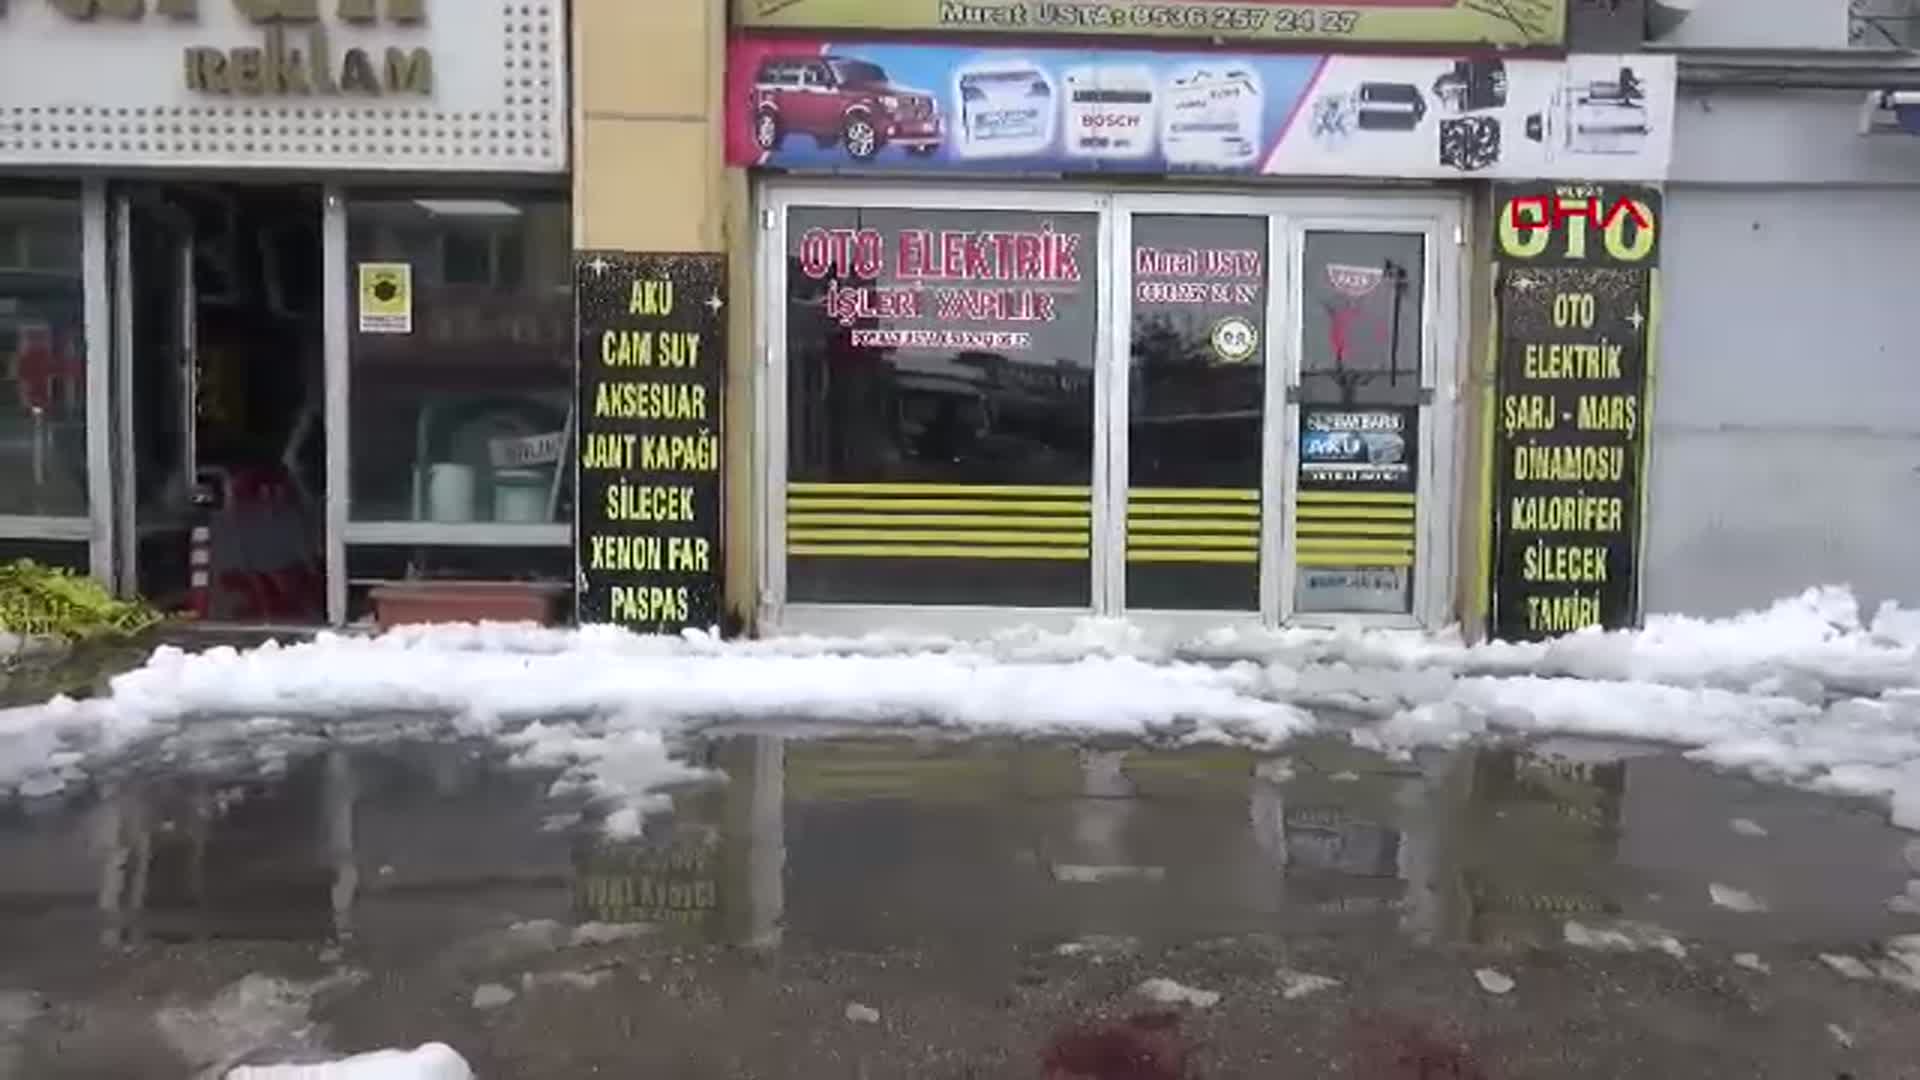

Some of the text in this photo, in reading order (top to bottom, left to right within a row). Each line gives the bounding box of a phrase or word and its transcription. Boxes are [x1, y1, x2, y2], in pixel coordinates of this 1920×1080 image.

[1131, 5, 1207, 28] 0536
[1211, 7, 1269, 31] 257
[1274, 9, 1316, 33] 24
[1319, 10, 1360, 34] 27
[1081, 114, 1140, 128] BOSCH
[800, 220, 1081, 282] OTO ELEKTRİK
[826, 280, 1057, 325] İŞLERİ YAPILIR
[1553, 293, 1595, 328] OTO
[602, 329, 700, 368] CAM SUY
[1525, 337, 1622, 379] ELEKTRİK
[596, 381, 707, 420] AKSESUAR
[1505, 395, 1556, 439] ŞARJ
[1577, 395, 1637, 440] MARŞ
[583, 433, 637, 470] JANT
[641, 427, 718, 471] KAPAĞI
[1514, 438, 1624, 482] DİNAMOSU
[606, 477, 695, 521] SİLECEK
[1511, 489, 1623, 532] KALORİFER
[591, 536, 710, 572] XENON FAR
[1523, 538, 1608, 582] SİLECEK
[611, 586, 689, 622] PASPAS
[1527, 588, 1601, 631] TAMİRİ
